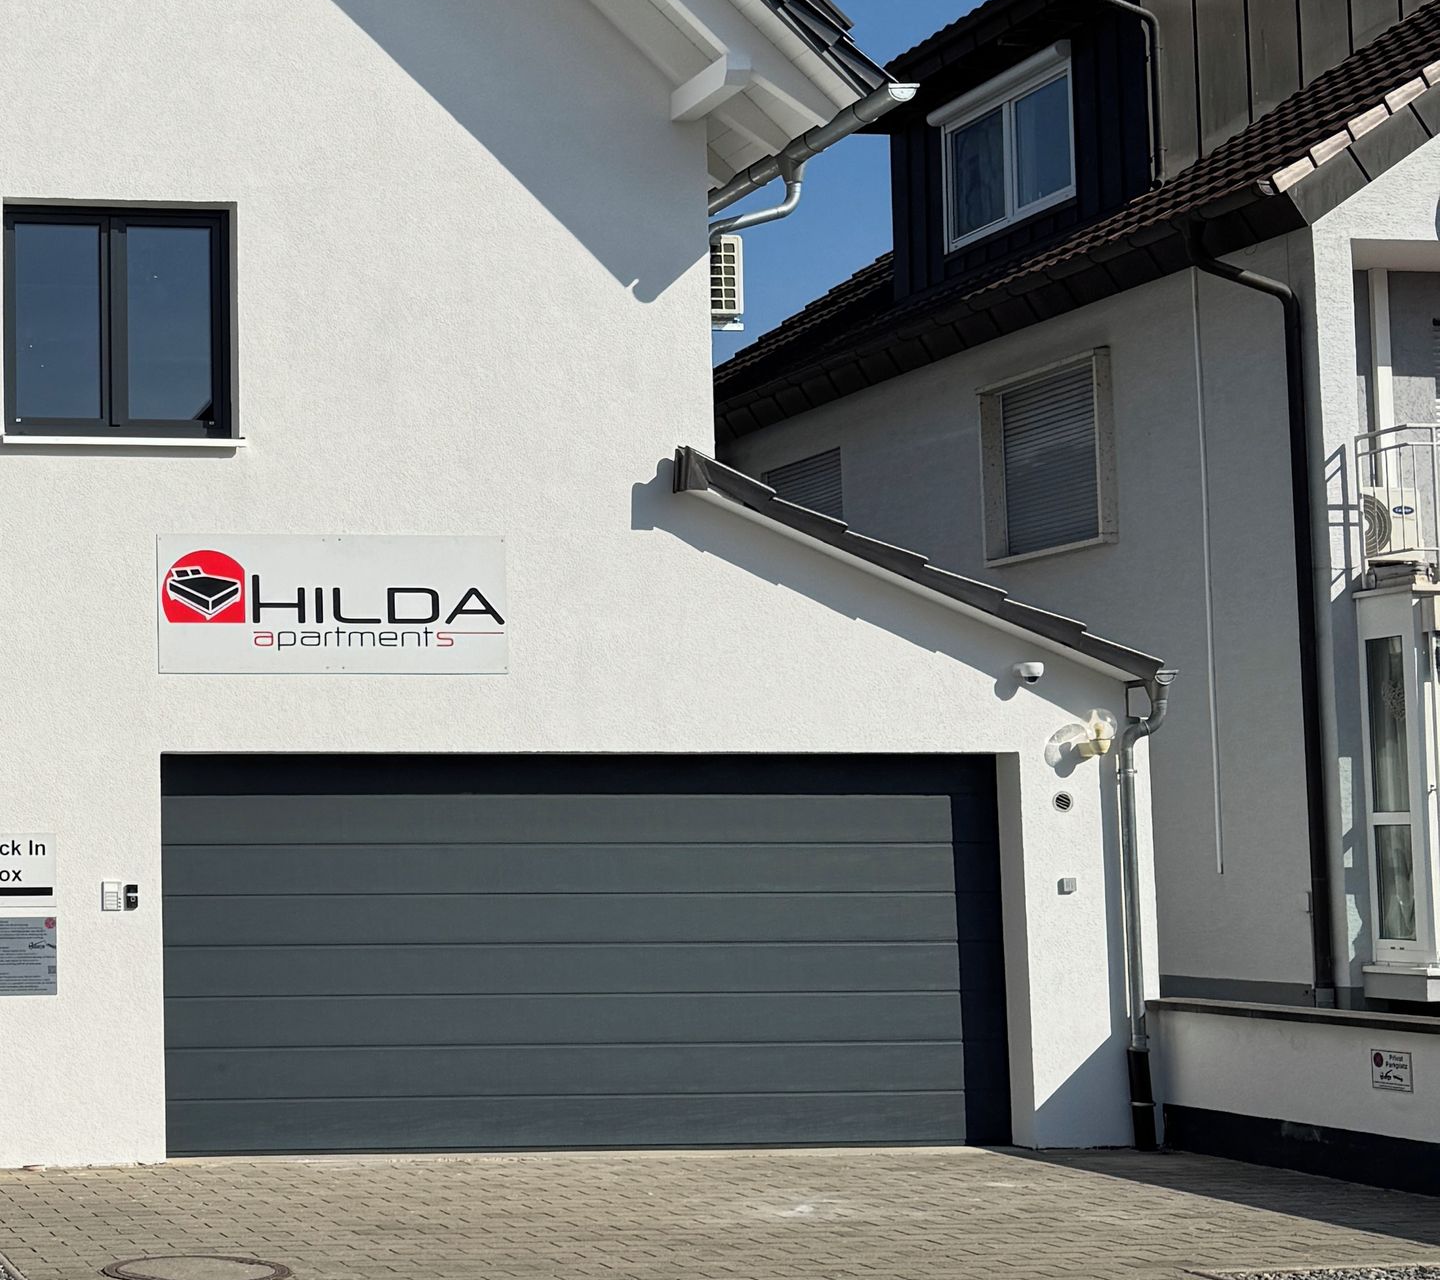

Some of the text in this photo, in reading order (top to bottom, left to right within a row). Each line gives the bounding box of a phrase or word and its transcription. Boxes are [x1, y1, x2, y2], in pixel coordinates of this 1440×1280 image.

[252, 574, 505, 624] HILDA
[253, 626, 455, 651] apartments
[29, 840, 46, 856] In
